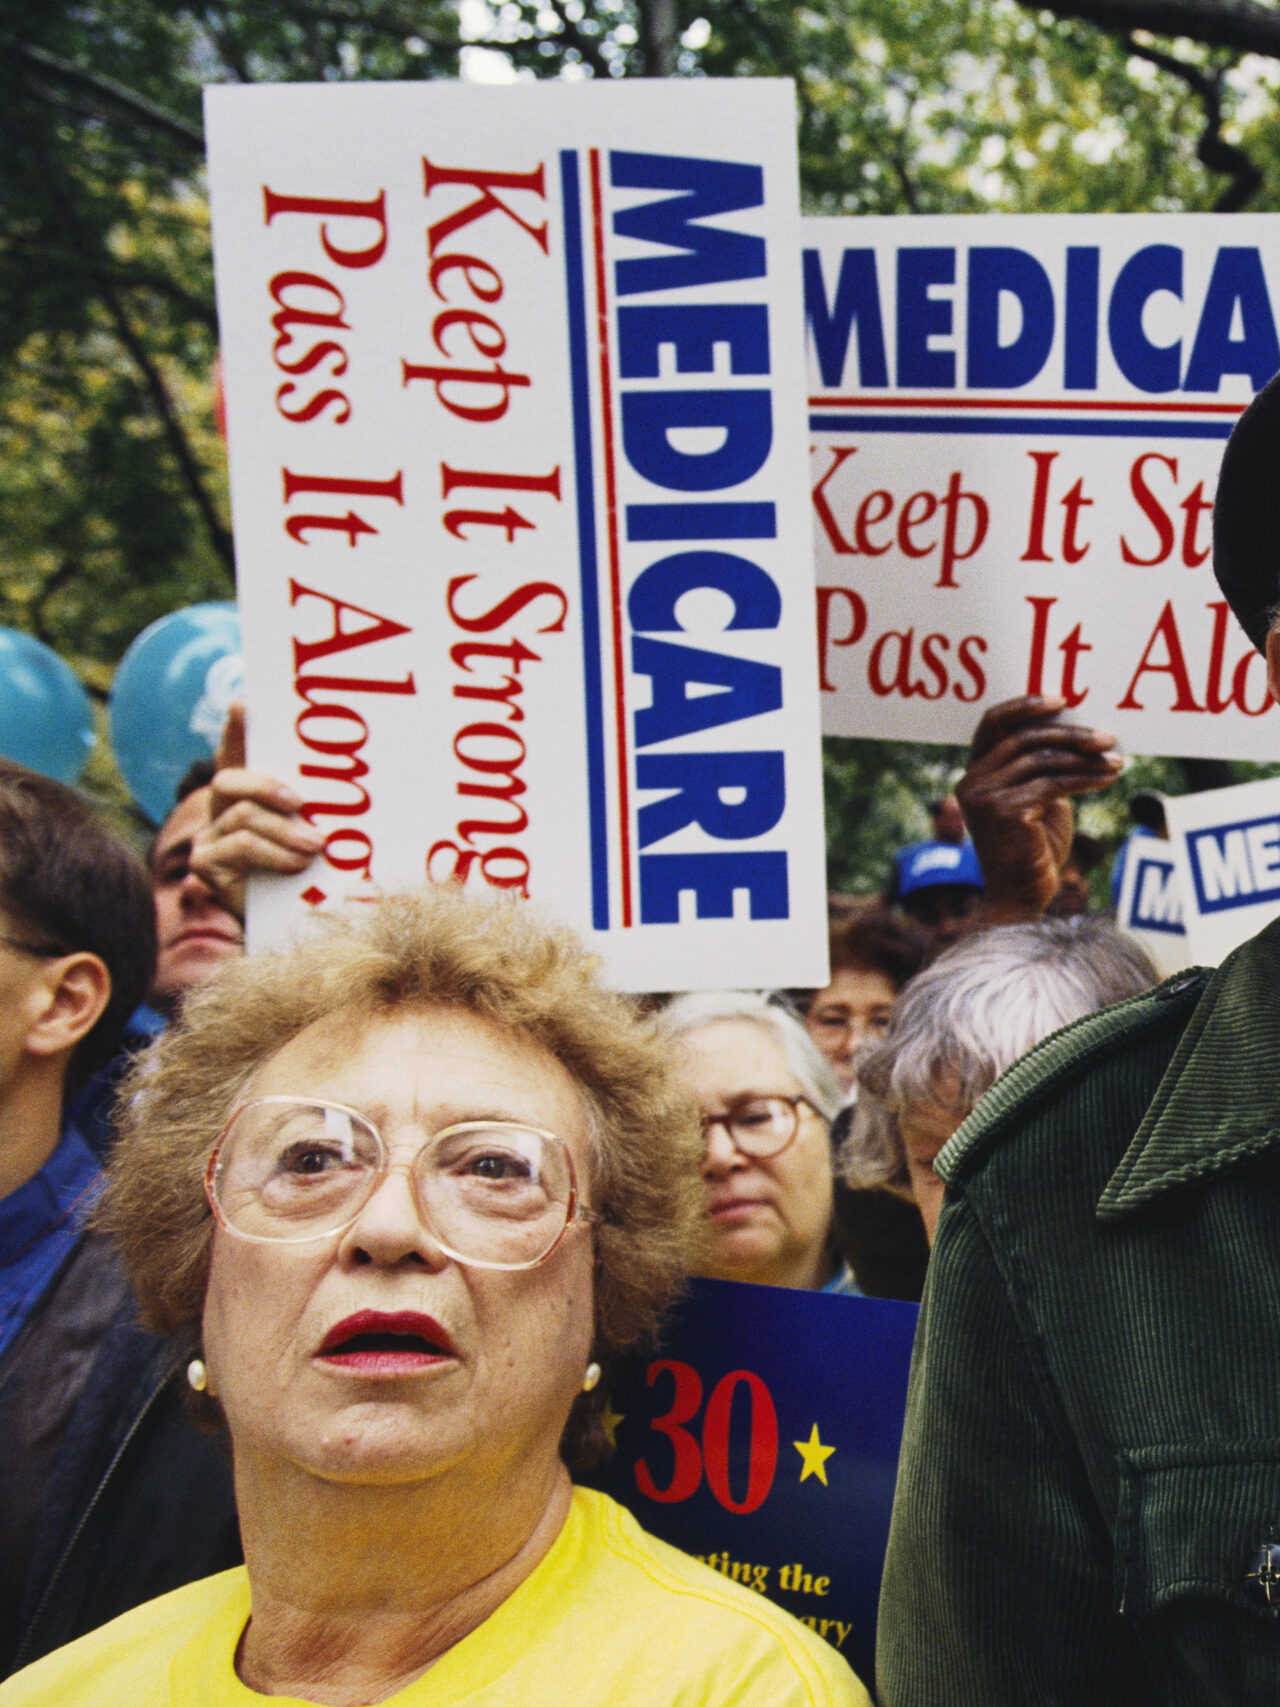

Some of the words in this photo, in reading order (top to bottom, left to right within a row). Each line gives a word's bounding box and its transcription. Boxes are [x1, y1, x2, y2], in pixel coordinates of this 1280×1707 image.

[262, 185, 389, 425] Pass
[402, 156, 549, 423] Keep
[281, 466, 405, 547] It
[441, 462, 562, 543] It
[610, 150, 789, 925] MEDICARE
[1020, 451, 1093, 564] It
[816, 586, 988, 702] Pass
[1025, 596, 1092, 709] It
[427, 573, 567, 899] Strong
[634, 1359, 778, 1514] 30
[778, 1563, 831, 1596] the
